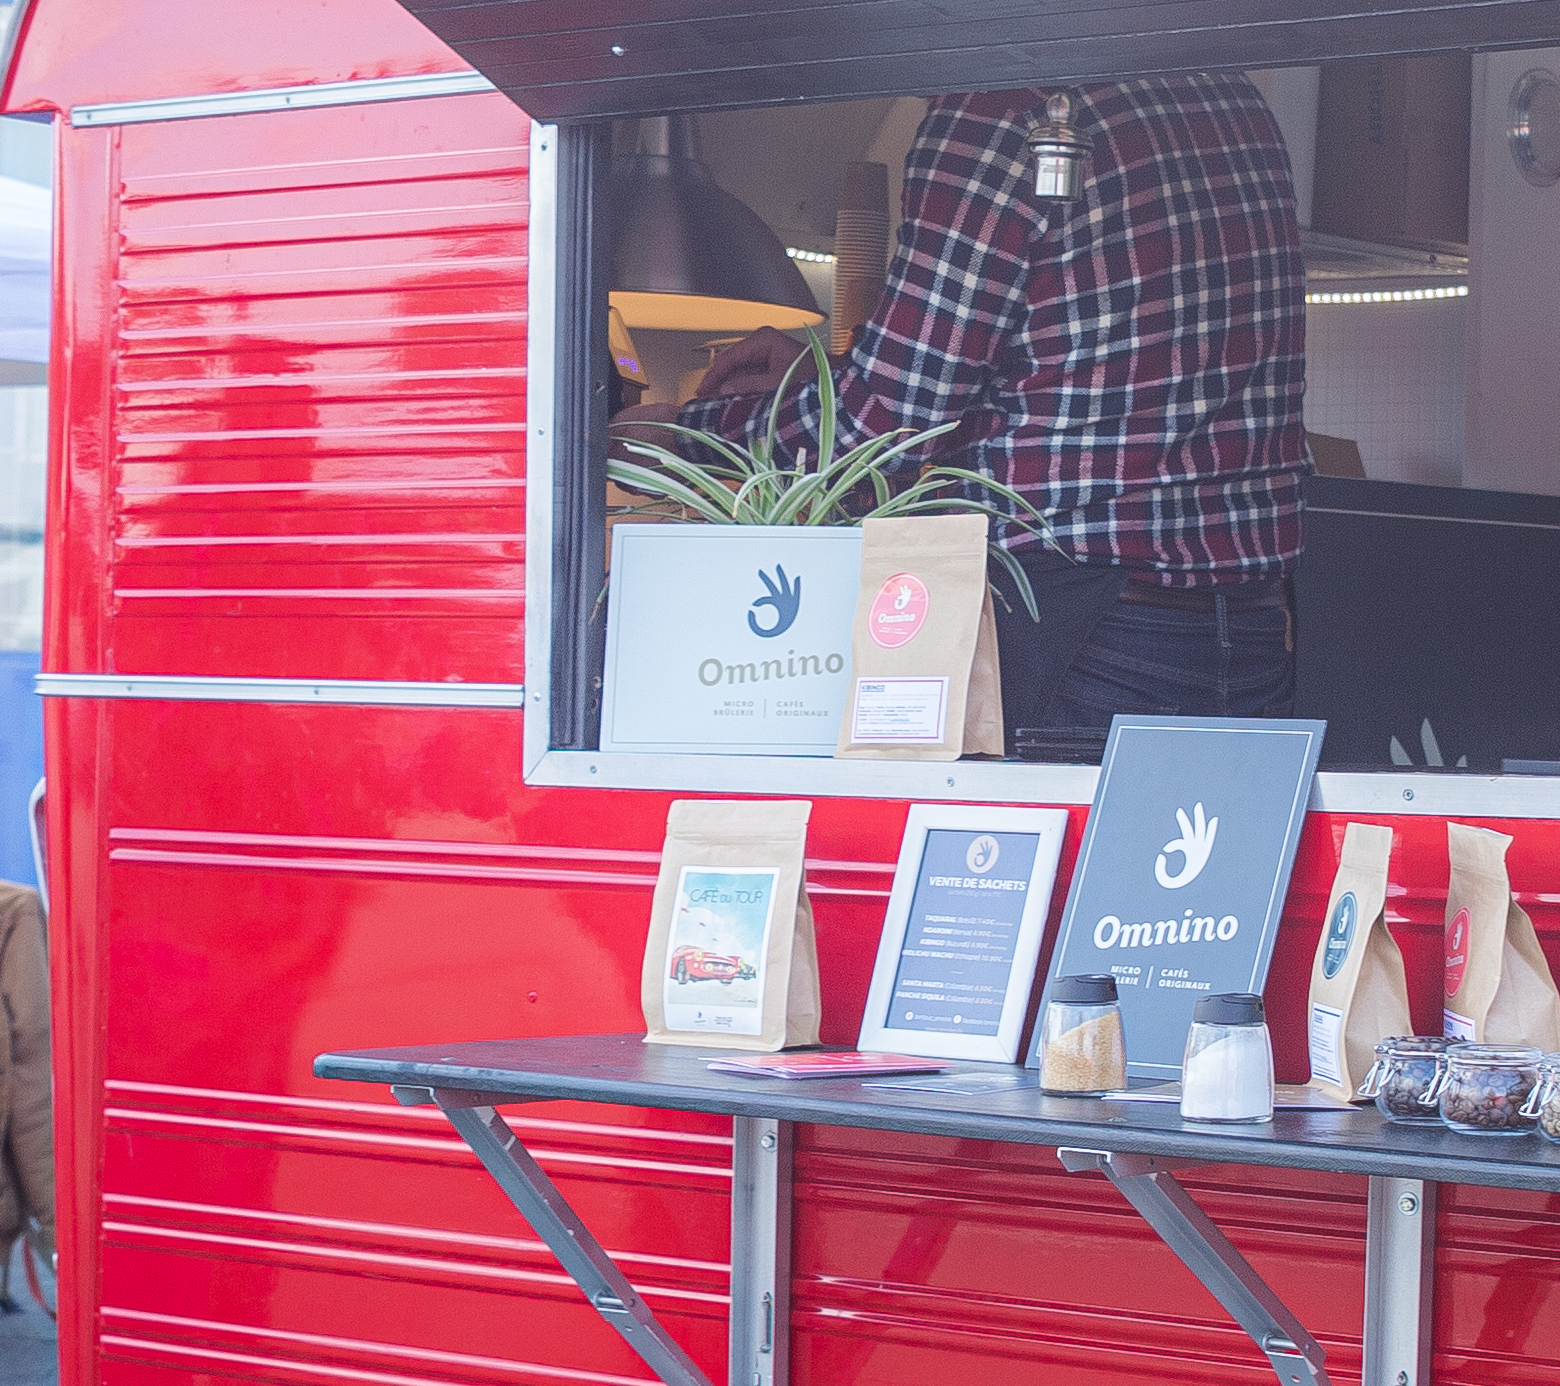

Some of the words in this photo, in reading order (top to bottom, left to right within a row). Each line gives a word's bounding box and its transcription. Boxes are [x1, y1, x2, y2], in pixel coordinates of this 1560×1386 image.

[698, 649, 844, 686] Omnino
[724, 700, 754, 708] MICRO
[776, 699, 804, 708] CAFÉS
[713, 709, 754, 717] BRÛLERIE
[775, 709, 829, 717] ORIGINAUX
[929, 876, 962, 888] VENTE
[962, 877, 978, 889] DE
[978, 879, 1026, 892] SACHETS
[690, 887, 718, 904] CAFÉ
[735, 890, 764, 904] TOUR
[1093, 908, 1239, 949] Omnino
[1110, 965, 1141, 975] MICRO
[1160, 968, 1189, 979] CAFÉS
[1158, 979, 1211, 991] ORIGINAUX
